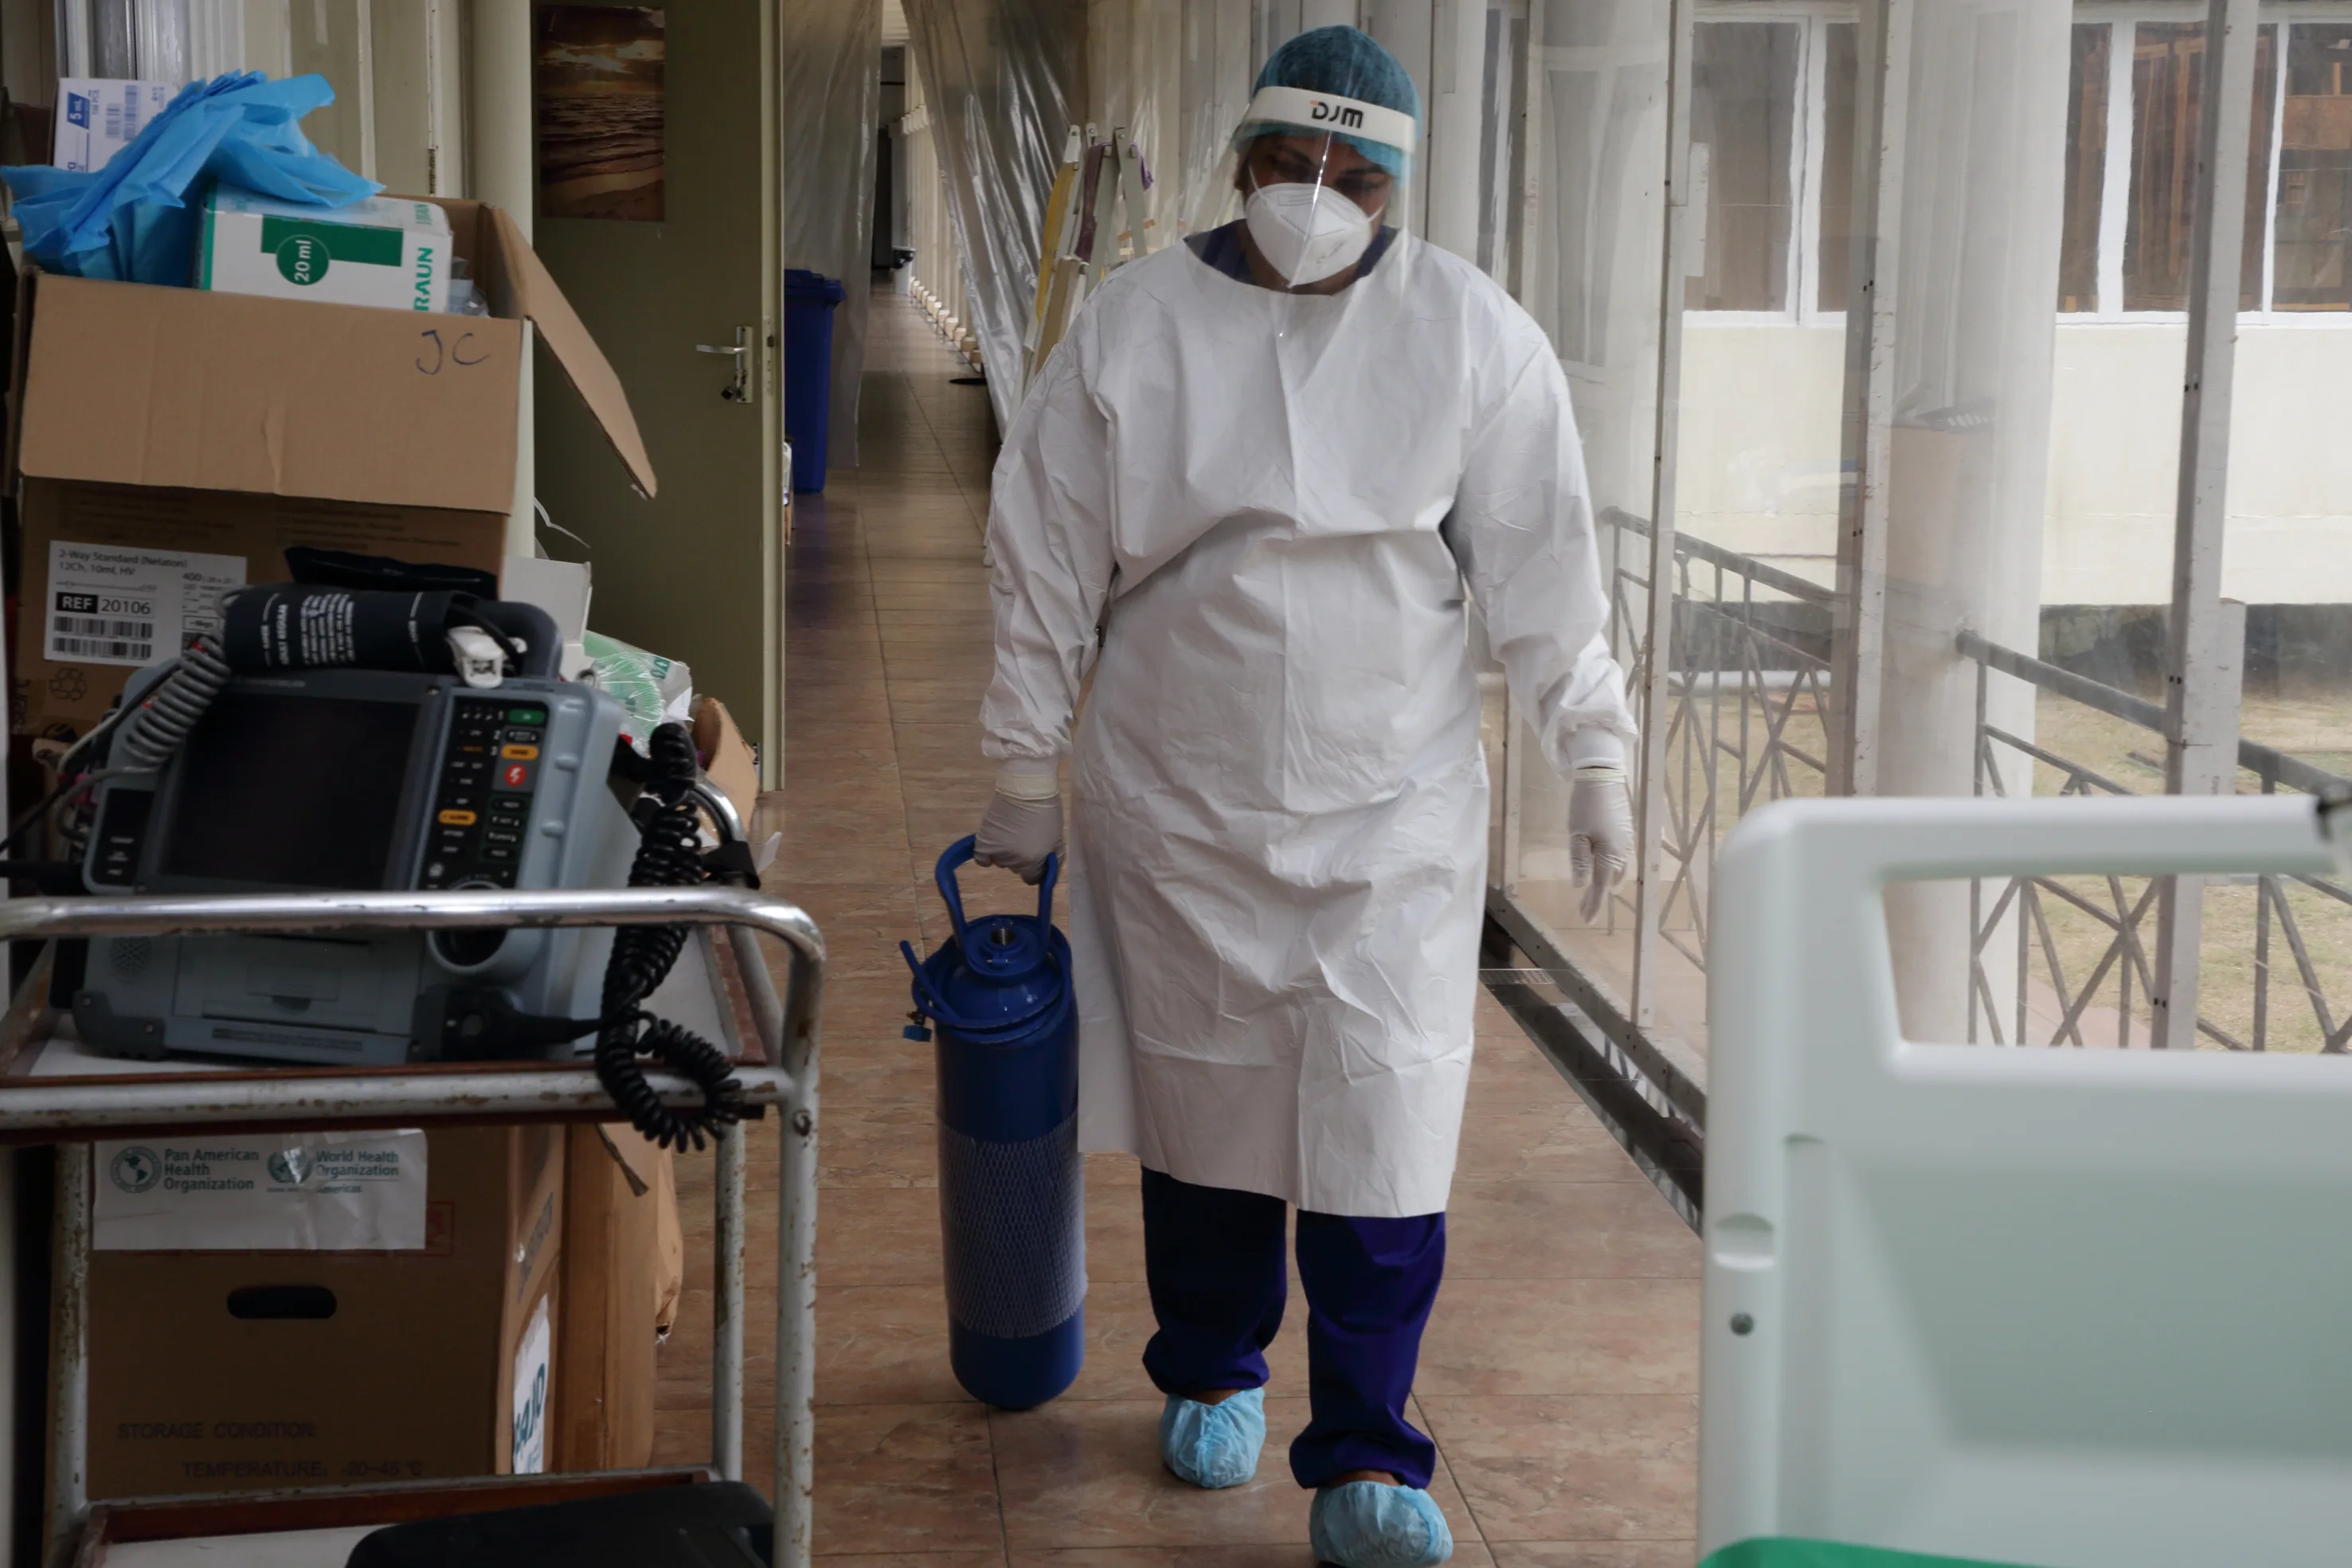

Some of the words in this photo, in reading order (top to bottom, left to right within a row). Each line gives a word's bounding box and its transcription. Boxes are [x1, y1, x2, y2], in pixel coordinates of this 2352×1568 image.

[69, 110, 82, 119] 5
[1310, 100, 1364, 129] DJM
[295, 240, 311, 260] ml
[294, 260, 311, 283] 20
[58, 549, 90, 562] 2-Way
[92, 551, 139, 565] Standard
[120, 567, 135, 576] HV
[62, 596, 93, 610] REF
[100, 599, 152, 615] 20106
[164, 1148, 188, 1162] Pan
[193, 1148, 260, 1162] American
[316, 1150, 354, 1163] World
[358, 1150, 399, 1163] Health
[164, 1163, 211, 1176] Health
[164, 1177, 255, 1194] Organization
[118, 1422, 204, 1439] STORAGE
